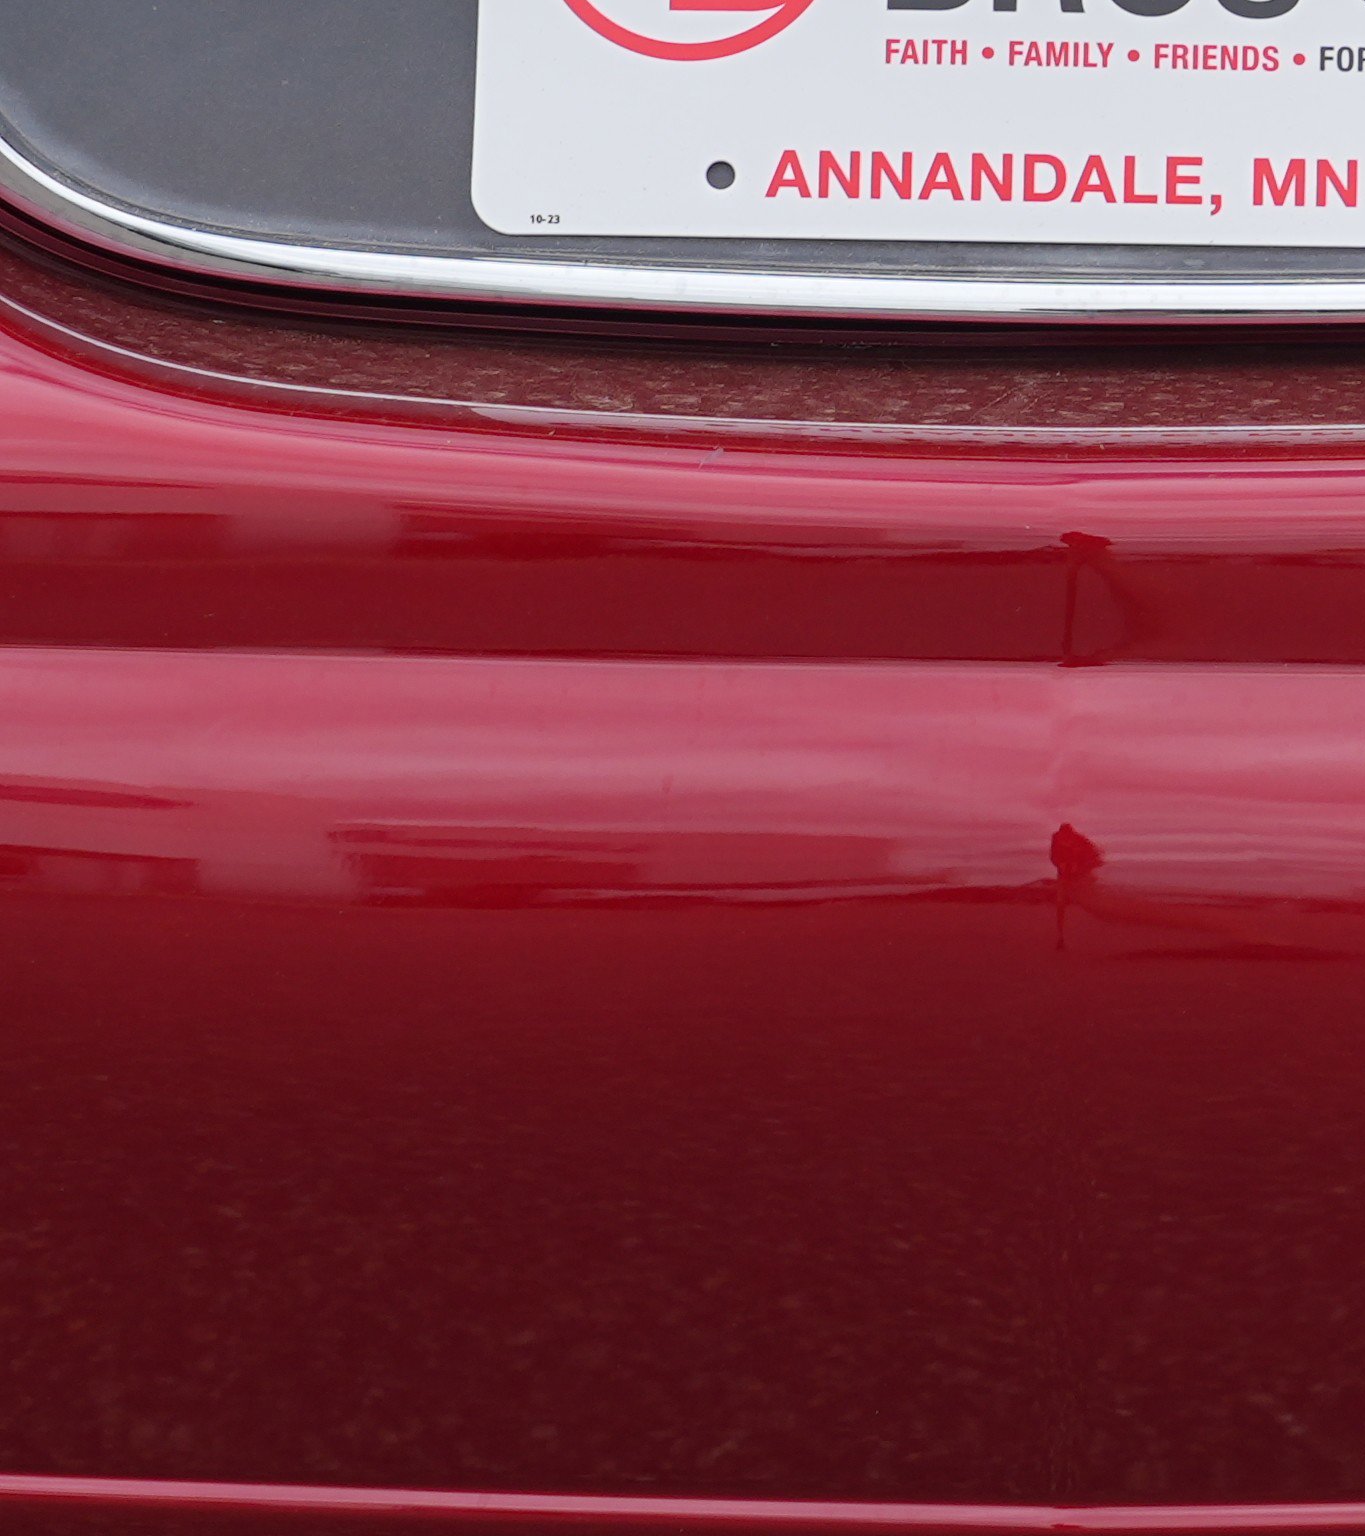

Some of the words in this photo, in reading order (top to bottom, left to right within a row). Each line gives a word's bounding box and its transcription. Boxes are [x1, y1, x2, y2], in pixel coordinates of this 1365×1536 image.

[885, 38, 968, 66] FAITH
[1008, 40, 1115, 69] FAMILY
[1154, 44, 1280, 72] FRIENDS
[765, 150, 1224, 217] ANNANDALE,
[1252, 158, 1361, 210] MN
